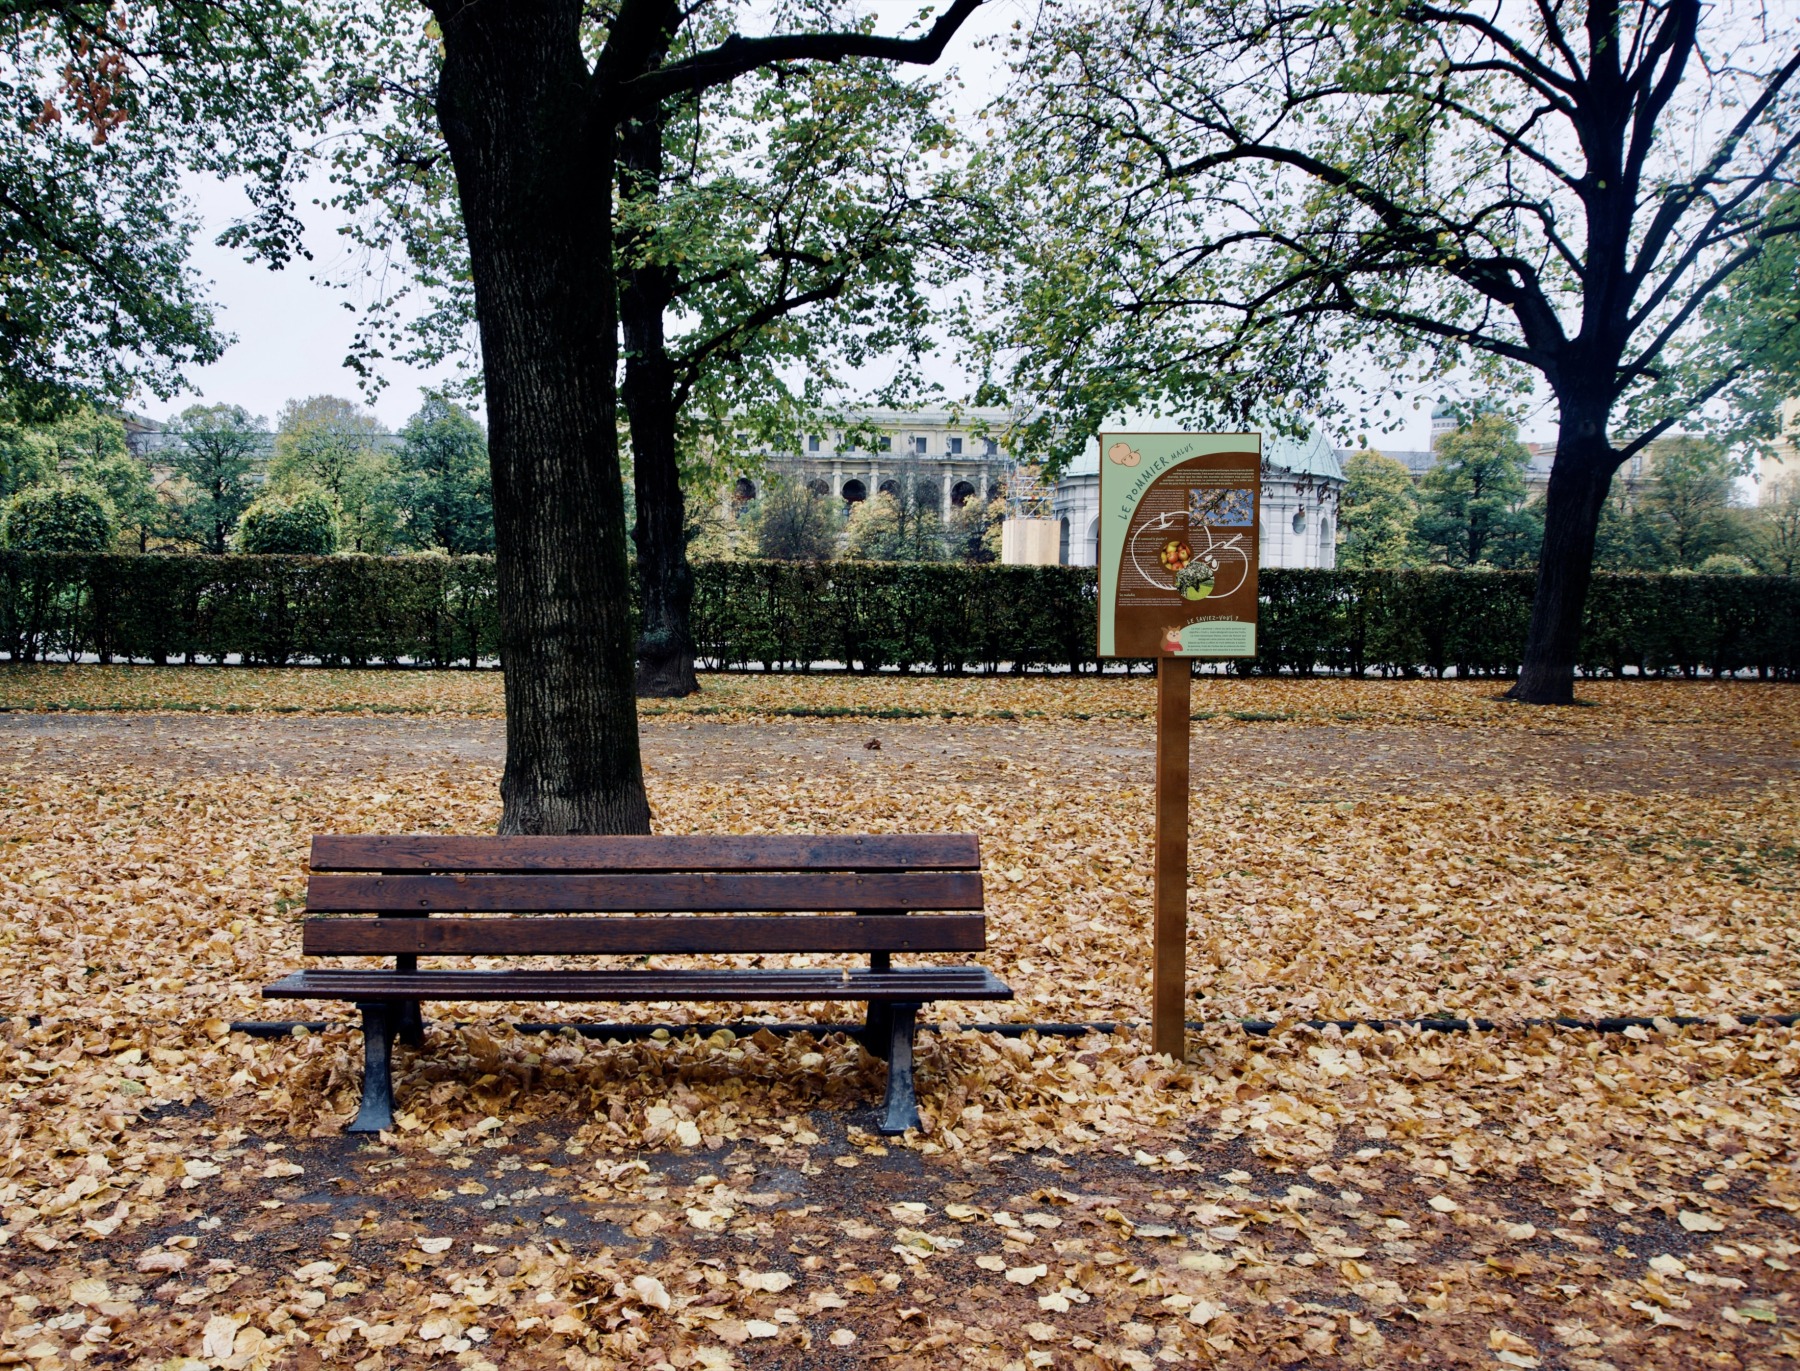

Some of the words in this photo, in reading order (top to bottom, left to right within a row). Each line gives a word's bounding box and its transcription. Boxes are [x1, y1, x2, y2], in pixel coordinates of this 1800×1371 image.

[1118, 505, 1131, 520] LE
[1126, 456, 1169, 502] POMMIER
[1170, 443, 1193, 460] MALUS
